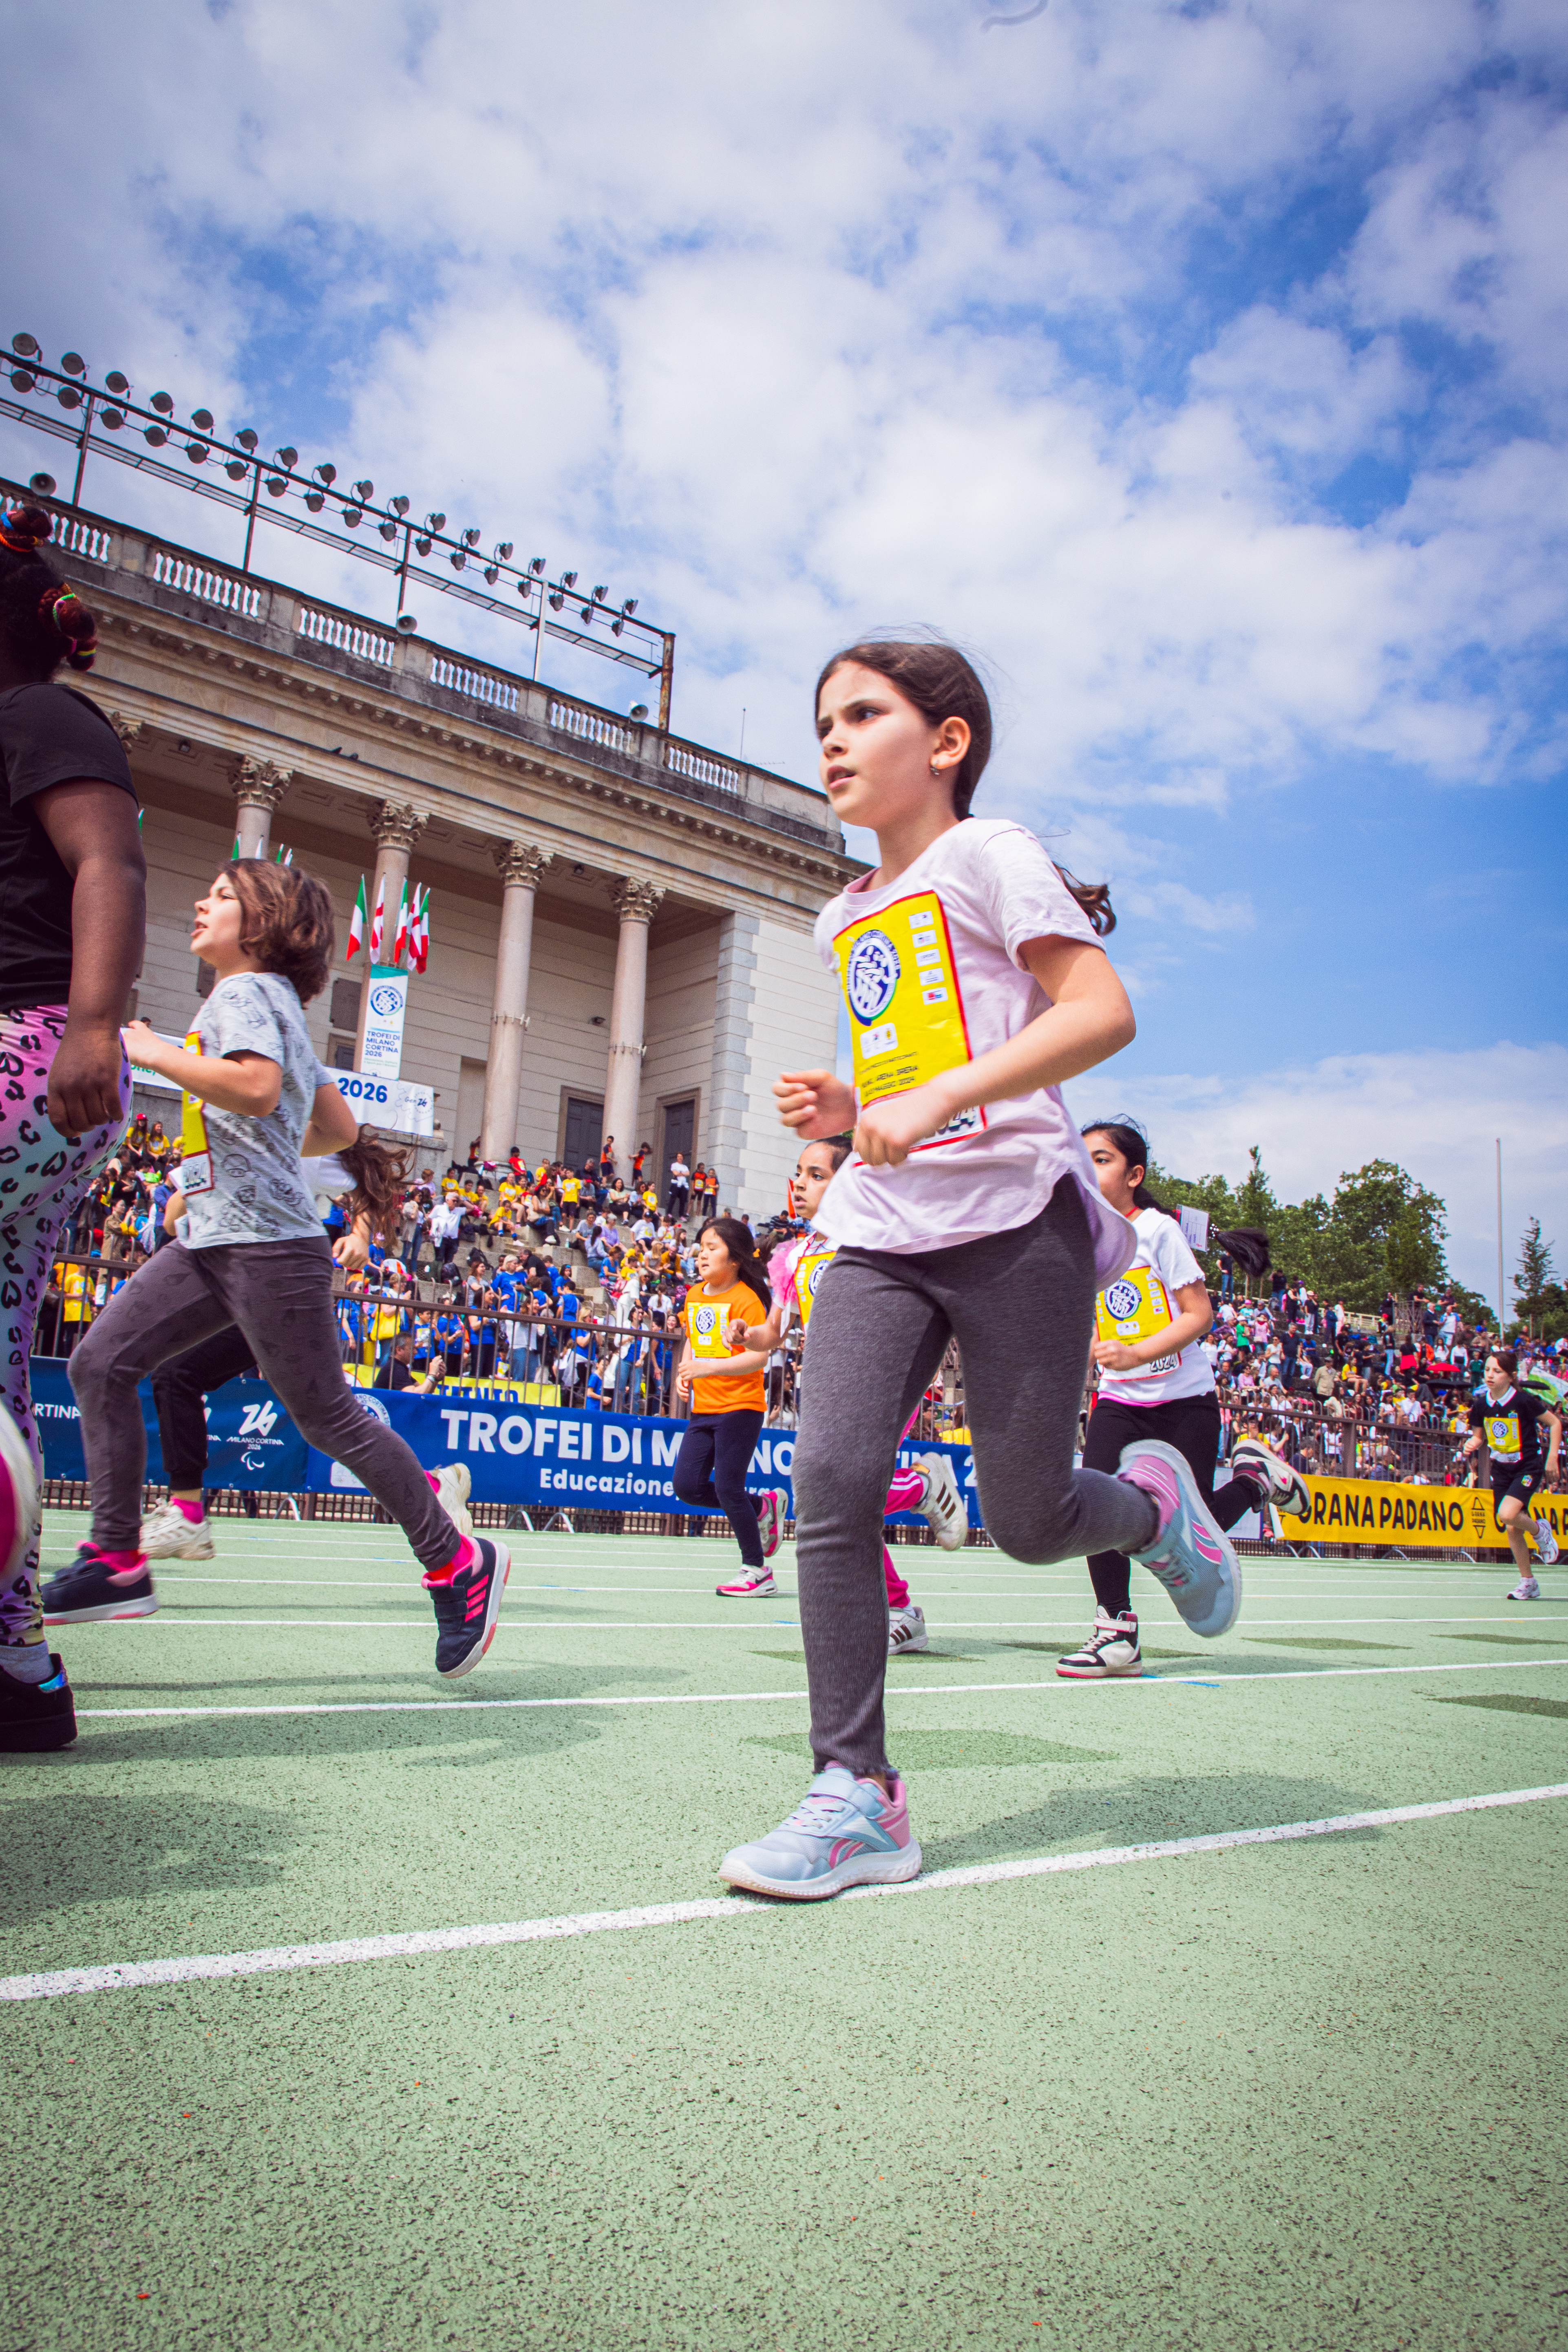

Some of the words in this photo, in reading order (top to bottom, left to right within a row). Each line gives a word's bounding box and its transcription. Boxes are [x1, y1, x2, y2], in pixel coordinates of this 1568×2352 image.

[366, 1038, 395, 1046] MILANO
[367, 1031, 391, 1039] TROFEI
[366, 1044, 398, 1053] CORTINA
[338, 1078, 387, 1103] 2026
[1150, 1353, 1177, 1373] 2024
[34, 1403, 82, 1419] RTINA
[255, 1438, 285, 1446] CORTINA
[441, 1409, 592, 1460] TROFEI
[602, 1424, 642, 1464] DI
[1380, 1497, 1464, 1532] PADANO
